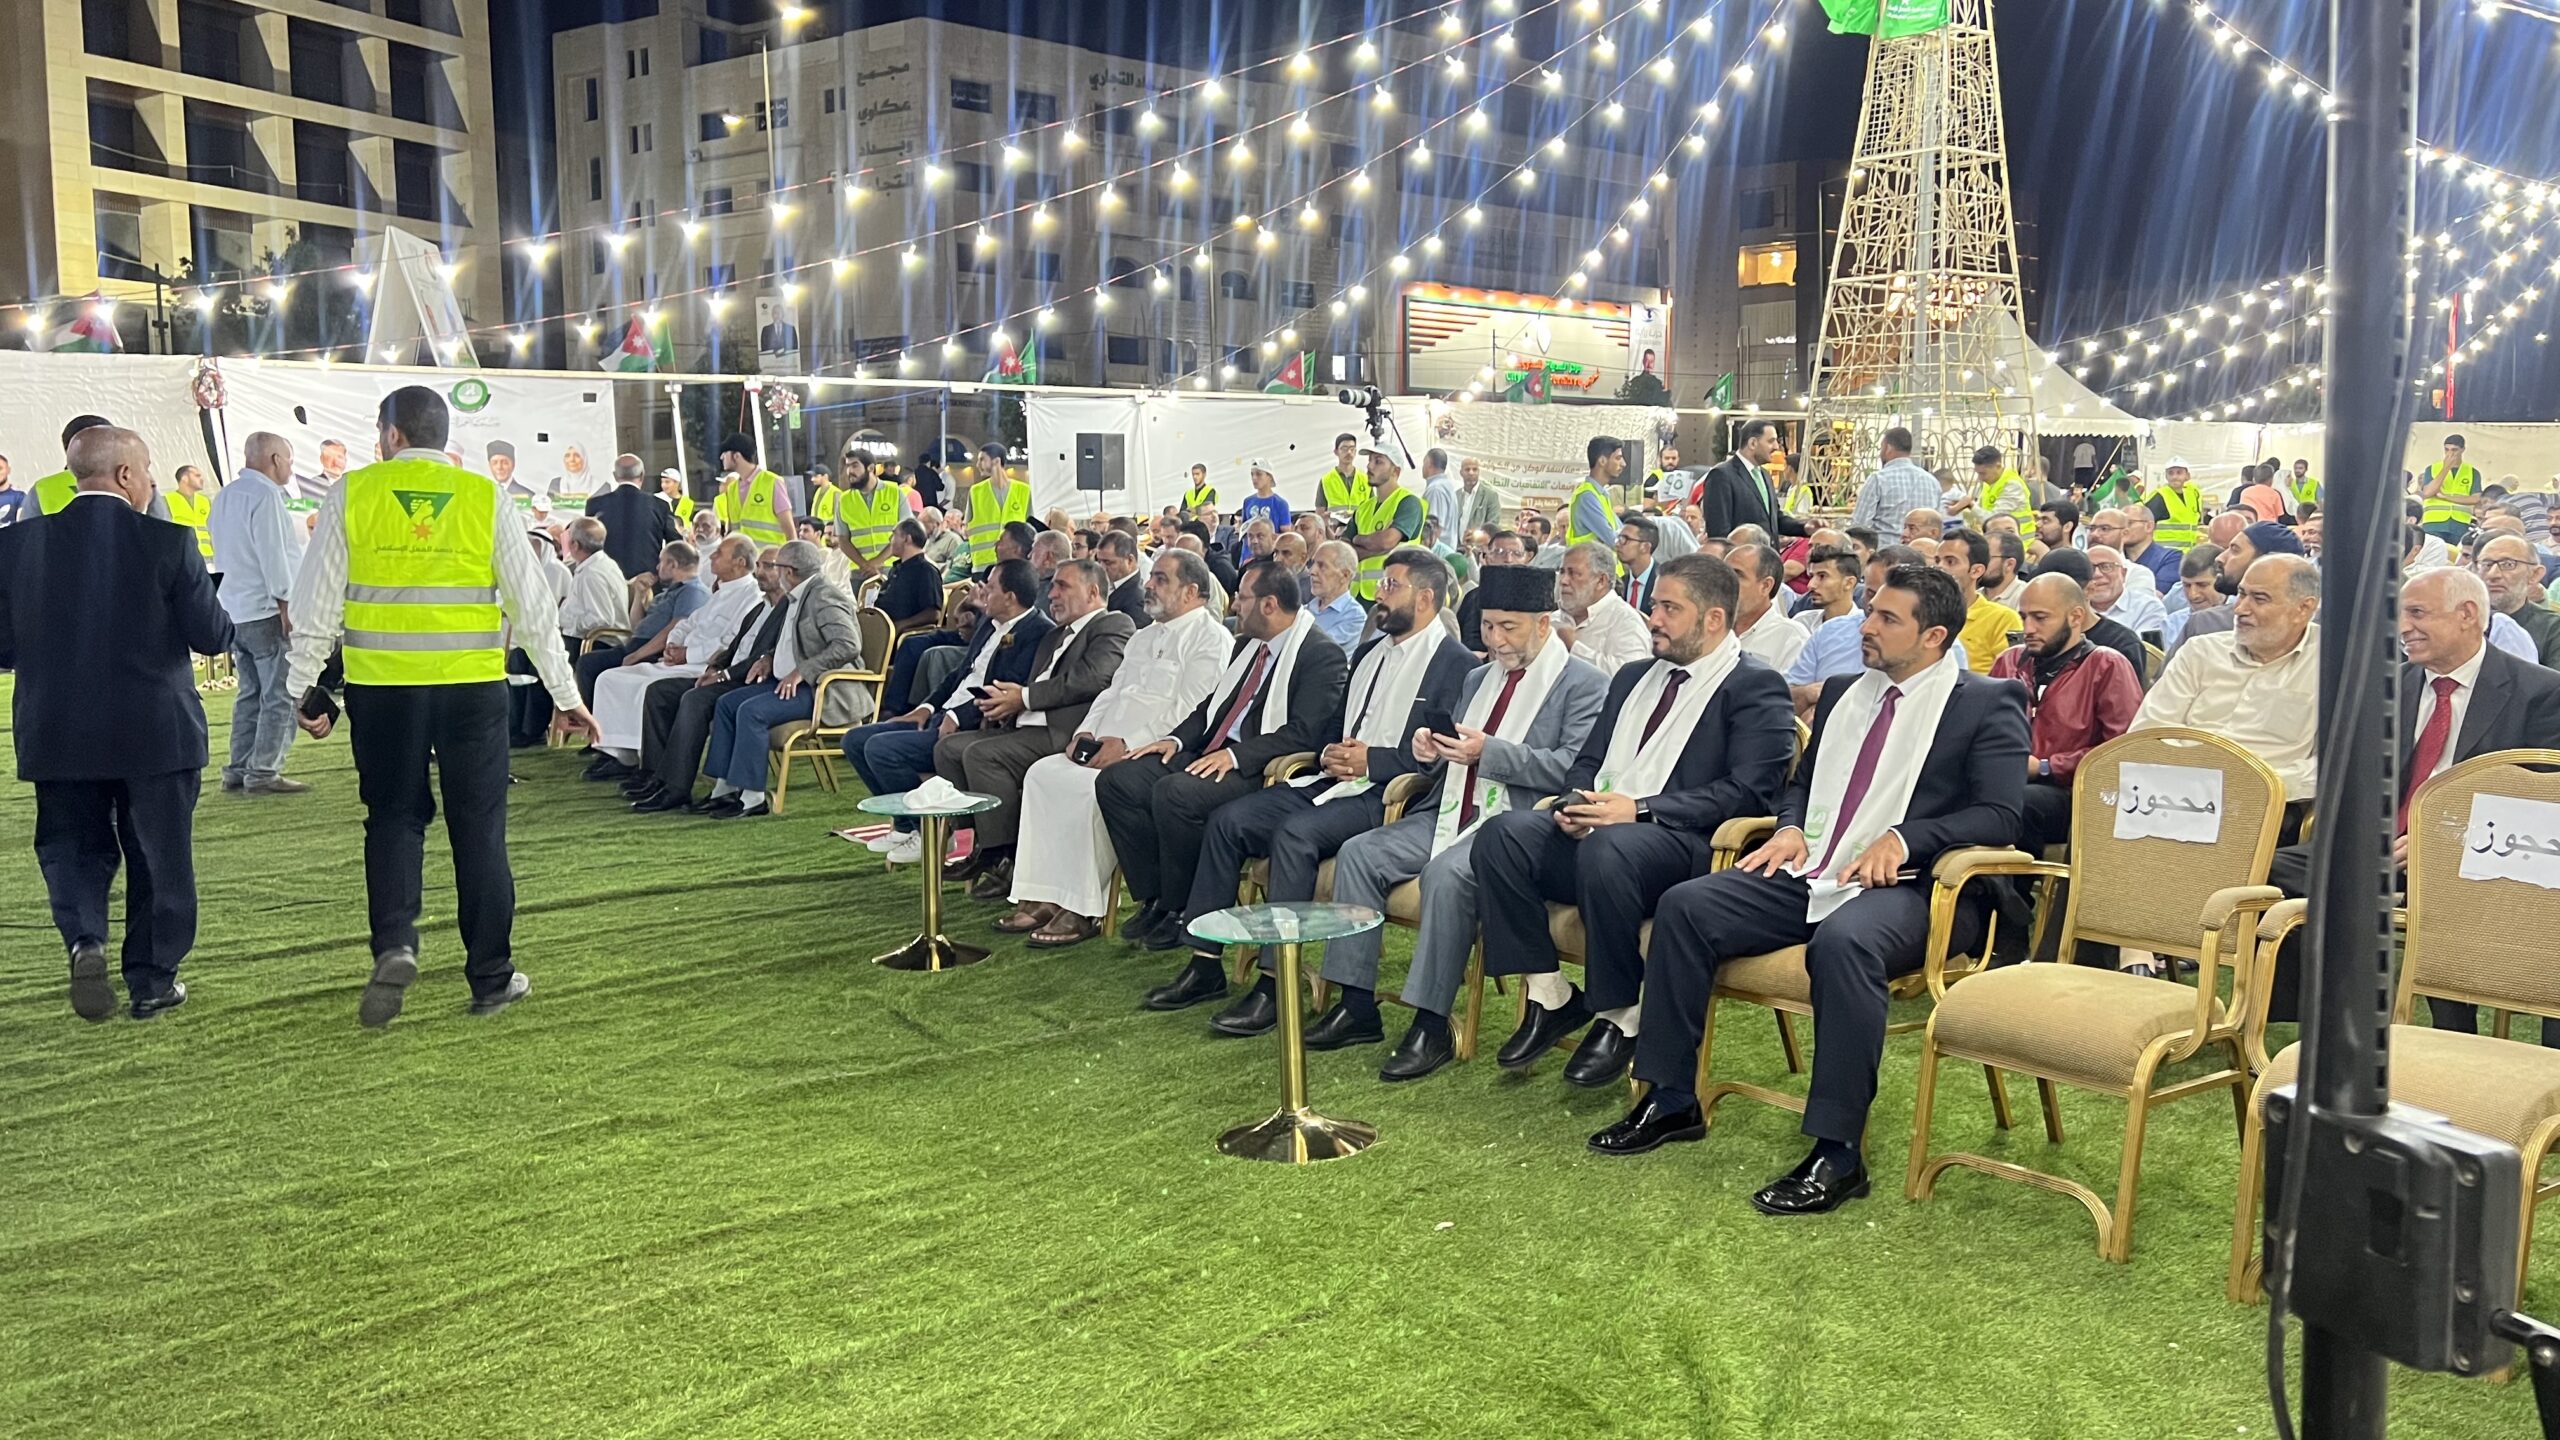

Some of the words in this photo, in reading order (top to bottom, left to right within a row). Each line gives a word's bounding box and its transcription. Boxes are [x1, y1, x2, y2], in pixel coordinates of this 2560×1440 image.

[857, 62, 909, 87] مجمع
[857, 98, 911, 126] عكاوي
[2122, 785, 2216, 818] محجوز
[2471, 821, 2560, 861] حجوز
